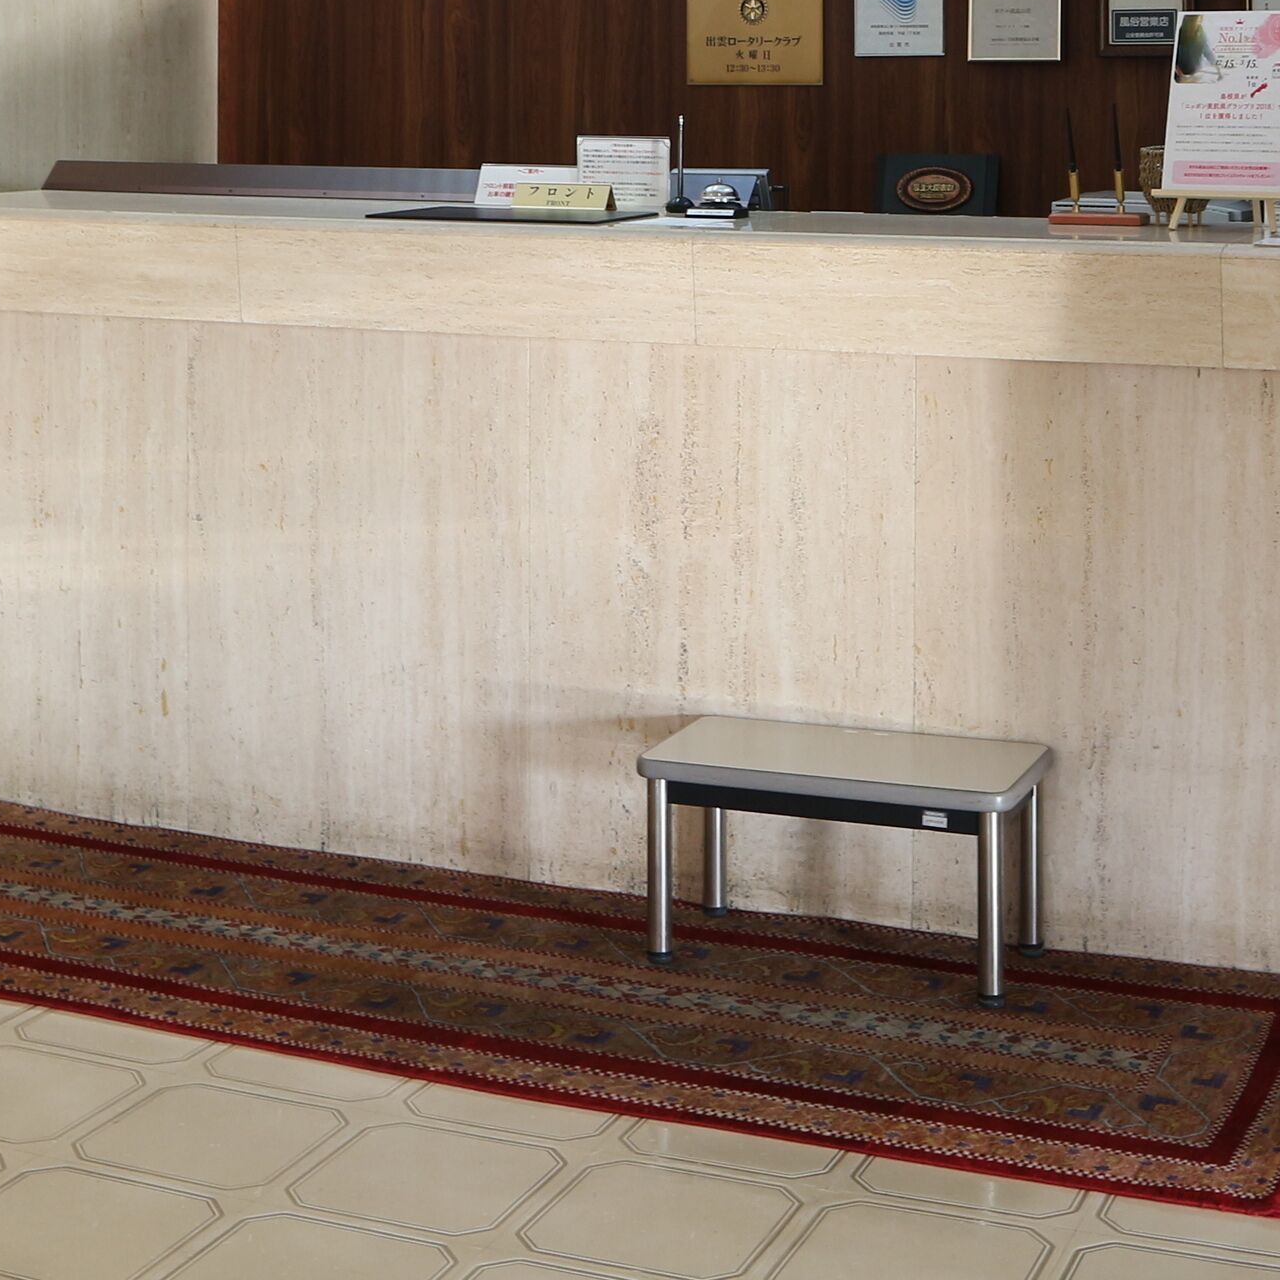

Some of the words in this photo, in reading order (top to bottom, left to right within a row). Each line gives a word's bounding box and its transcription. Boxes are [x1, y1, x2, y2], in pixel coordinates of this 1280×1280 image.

[705, 35, 802, 48] 出雲ロータリークラブ
[528, 185, 596, 200] フロント
